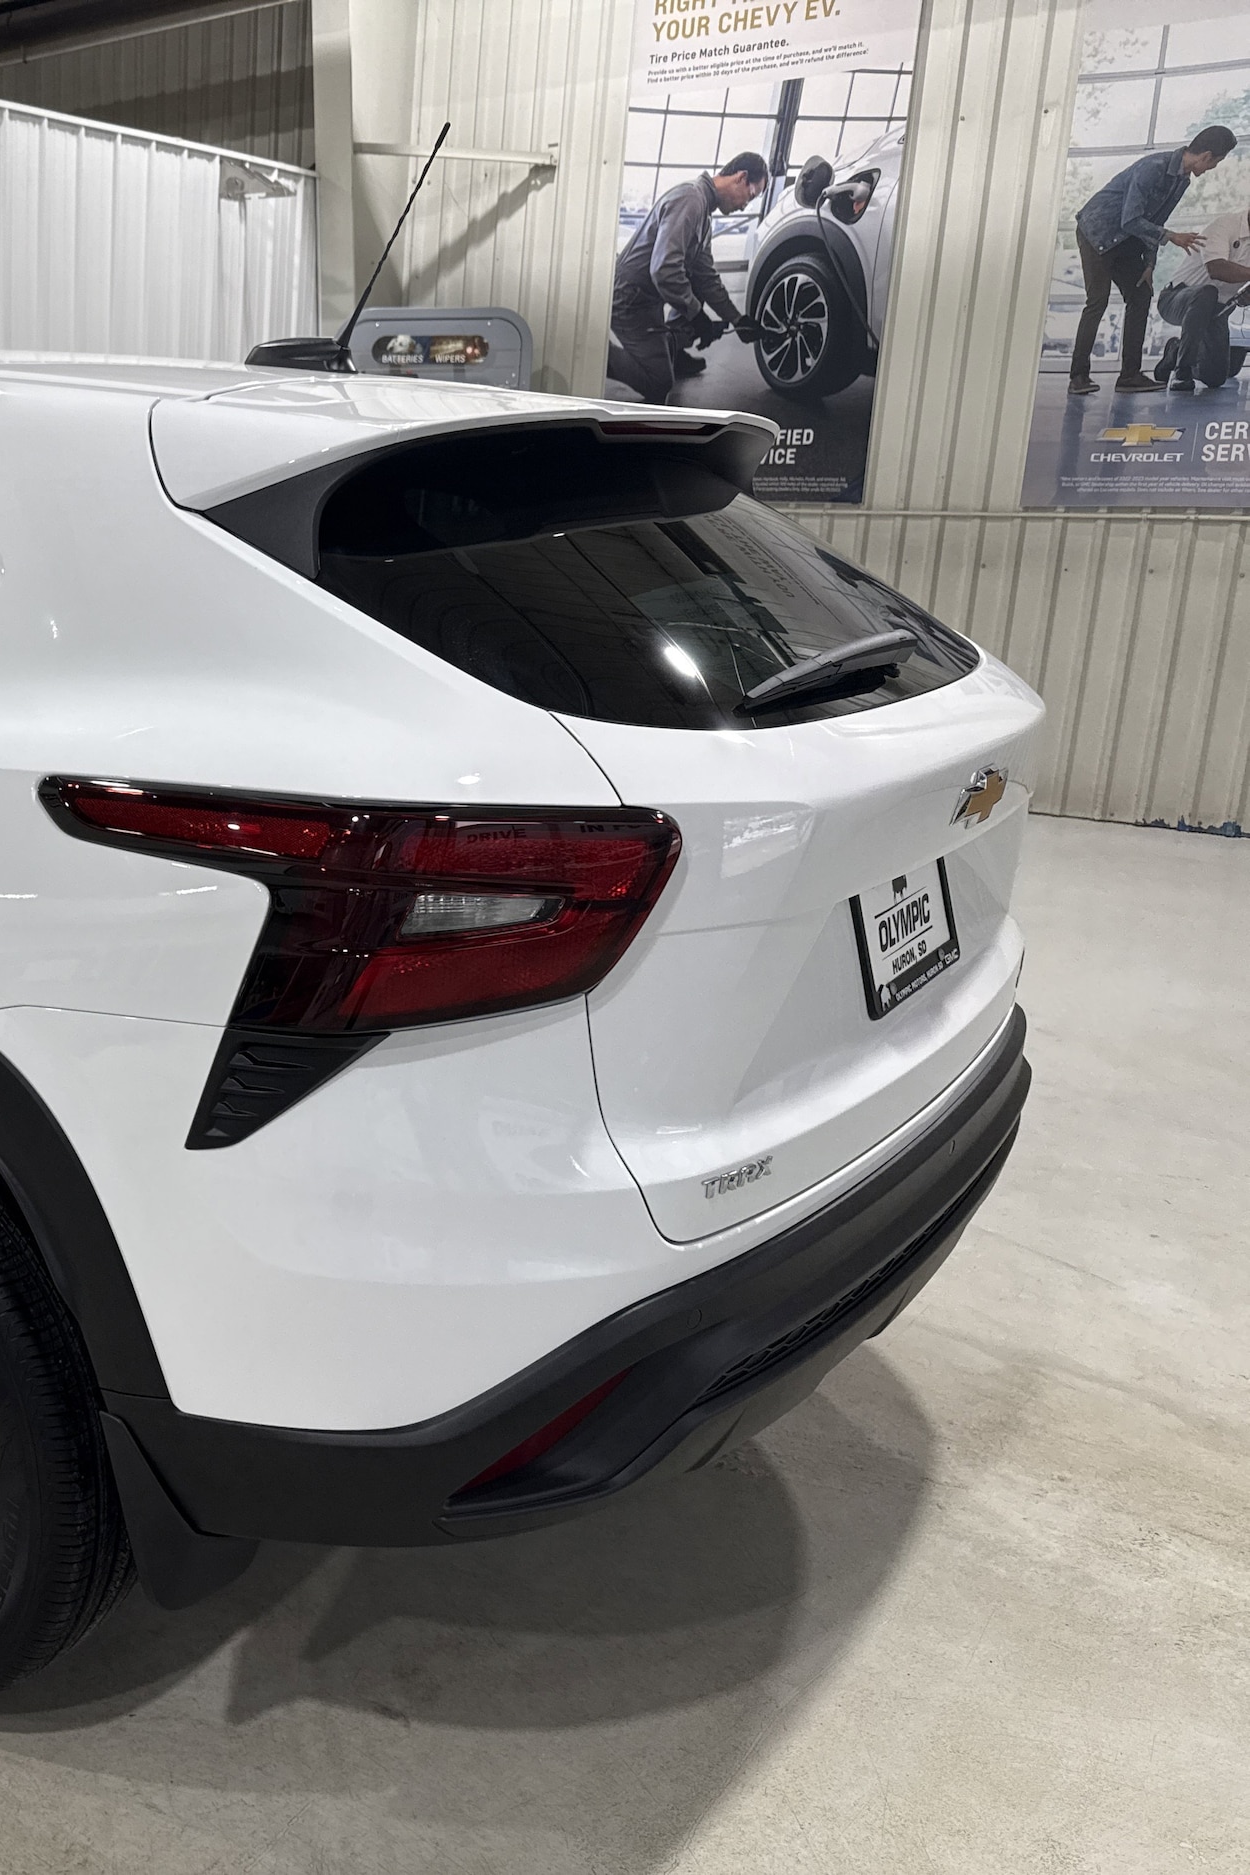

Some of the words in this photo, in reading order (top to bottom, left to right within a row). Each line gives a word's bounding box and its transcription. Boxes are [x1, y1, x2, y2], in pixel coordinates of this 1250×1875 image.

[653, 16, 711, 42] YOUR
[718, 1, 798, 34] CHEVY
[805, 0, 840, 20] EV.
[650, 54, 668, 65] Tire
[671, 51, 697, 62] Price
[699, 45, 730, 59] Match
[733, 39, 789, 54] Guarantee.
[381, 354, 423, 364] BATTERIES
[435, 354, 466, 364] WIPERS
[1090, 452, 1185, 463] CHEVROLET
[467, 826, 527, 844] DRIVE
[878, 893, 930, 952] OLYMPIC
[892, 947, 918, 975] HURON,
[918, 939, 927, 957] SD
[701, 1155, 773, 1199] TRAX
